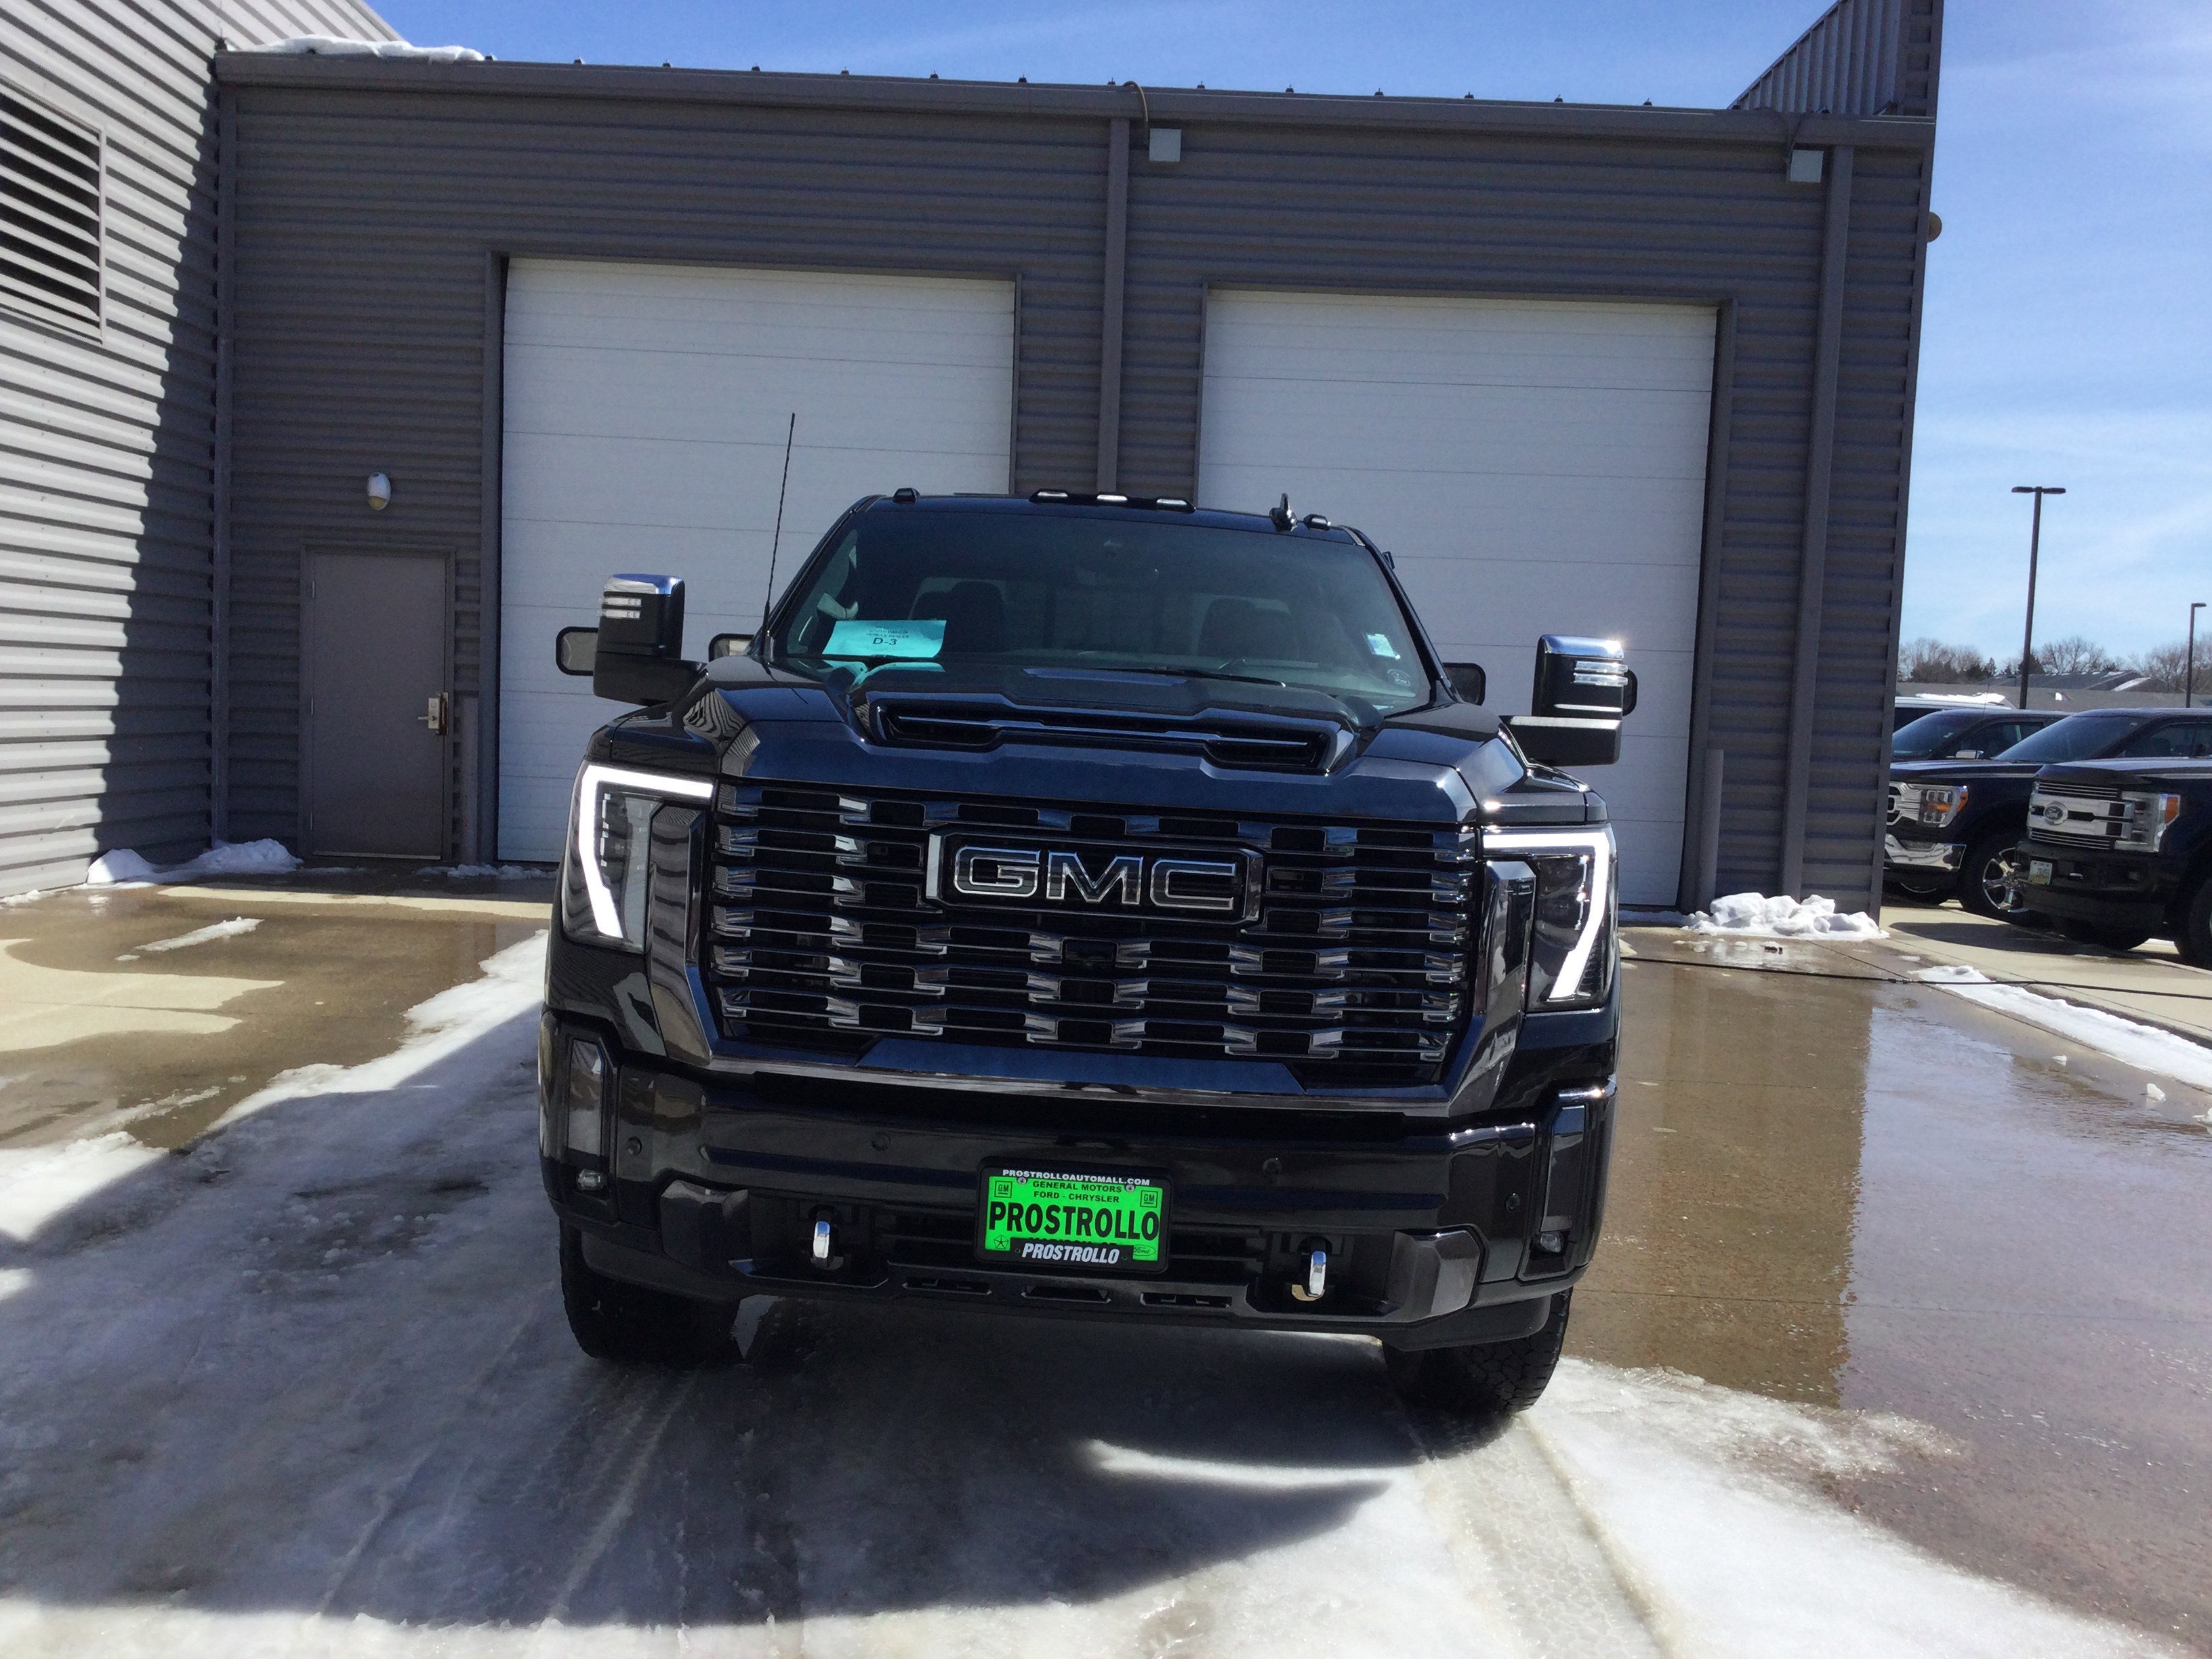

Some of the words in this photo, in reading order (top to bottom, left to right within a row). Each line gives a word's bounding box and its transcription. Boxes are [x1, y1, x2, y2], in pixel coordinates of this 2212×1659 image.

[872, 637, 897, 645] D-3
[954, 846, 1236, 910] GMC
[1002, 1169, 1150, 1186] PROSTROLLOAUTOMALL.COM
[998, 1184, 1009, 1193] GM
[1032, 1181, 1078, 1191] GENERAL
[1081, 1183, 1122, 1193] MOTORS
[1033, 1191, 1060, 1200] FORD
[1069, 1193, 1120, 1203] CHRYSLER
[1143, 1193, 1155, 1202] GM
[989, 1202, 1160, 1241] PROSTROLLO
[1022, 1243, 1120, 1264] PROSTROLLO
